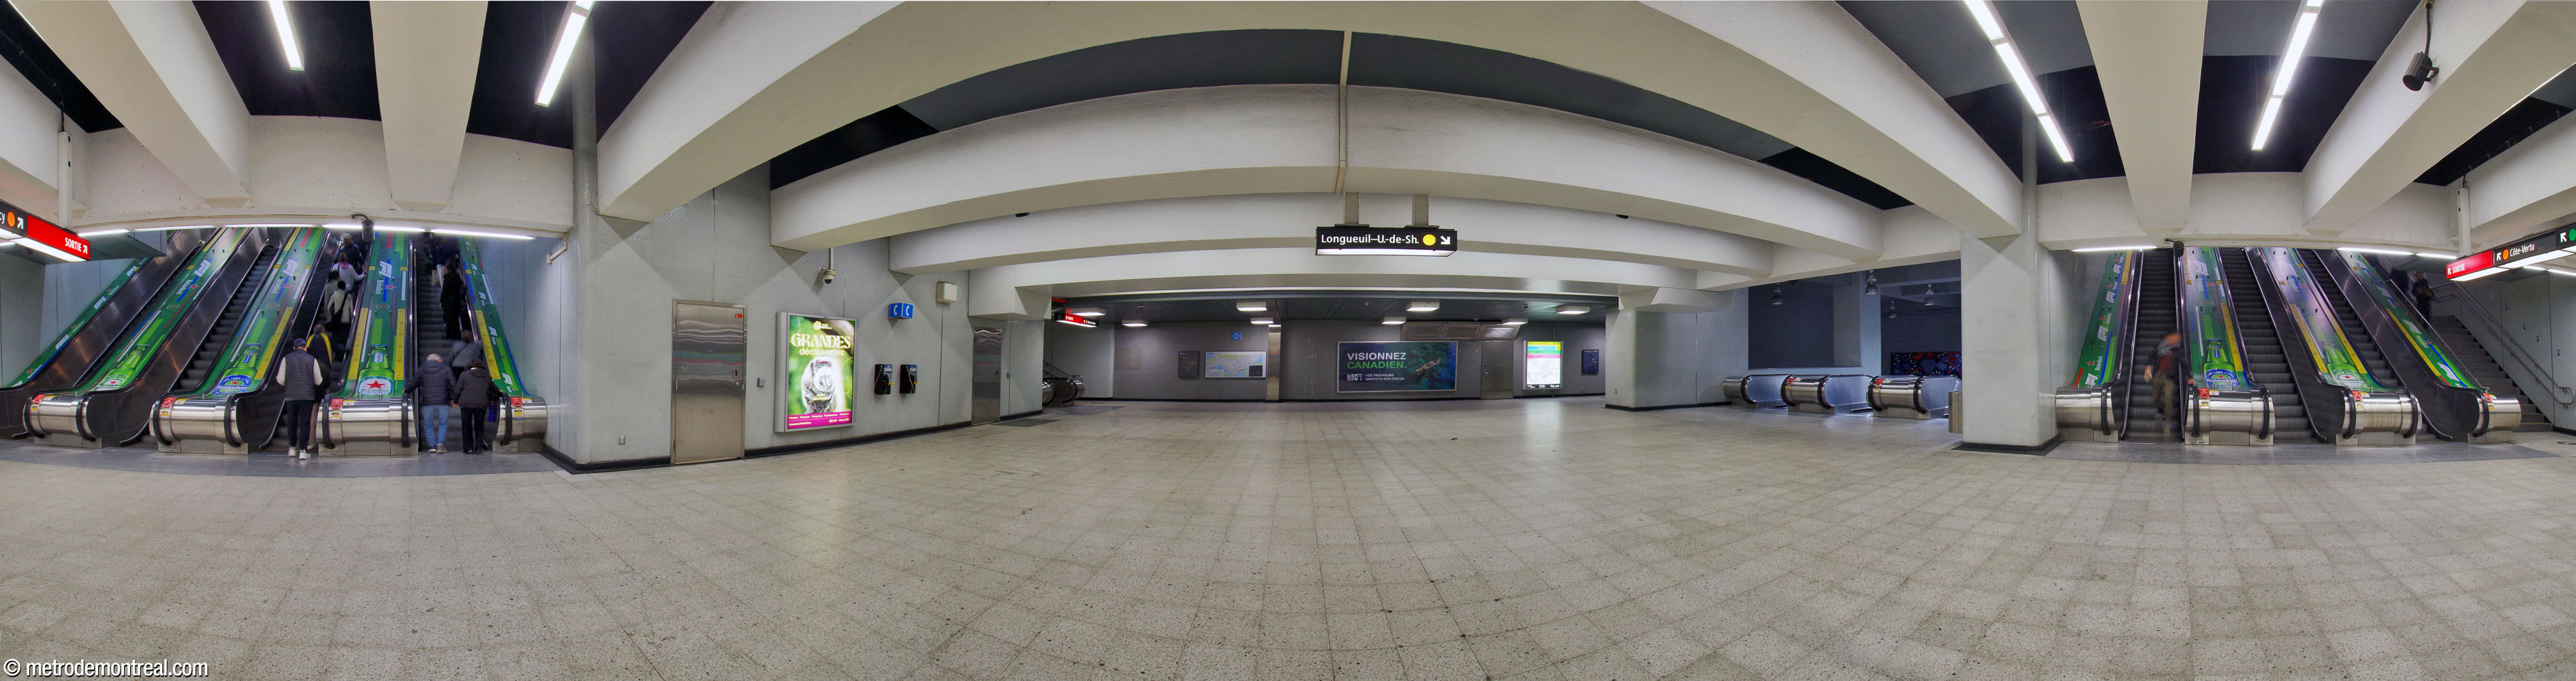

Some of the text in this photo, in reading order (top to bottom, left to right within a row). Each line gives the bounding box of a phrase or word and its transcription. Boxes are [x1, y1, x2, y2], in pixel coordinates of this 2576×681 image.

[65, 237, 82, 252] SORTIE
[2509, 243, 2534, 257] Côte-Vertu
[2452, 264, 2465, 274] SORTIE
[791, 333, 851, 349] GRANDES
[799, 347, 845, 356] découvertes
[1347, 352, 1407, 360] VISIONNEZ
[1347, 361, 1407, 369] CANADIEN.
